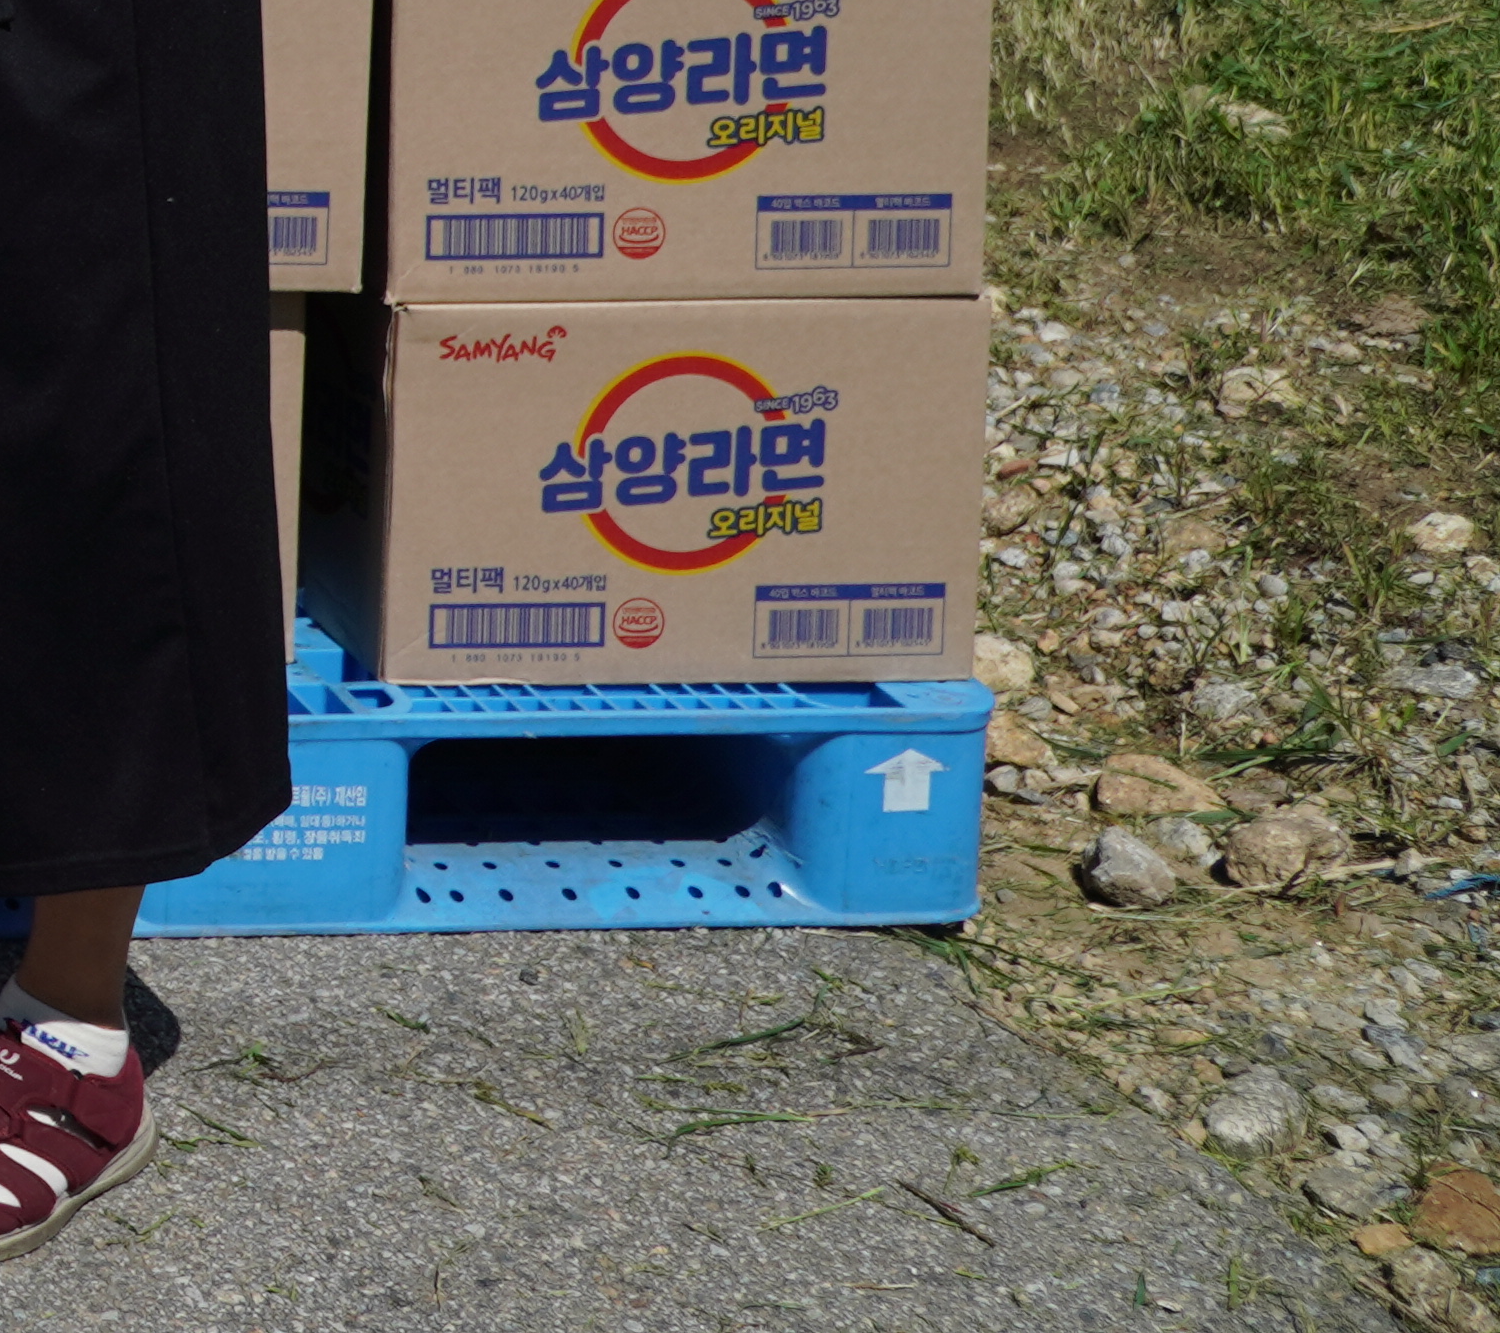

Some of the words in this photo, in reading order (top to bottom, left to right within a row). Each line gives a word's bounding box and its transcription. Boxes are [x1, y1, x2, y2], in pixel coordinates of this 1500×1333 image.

[754, 4, 789, 20] SINCE
[535, 25, 828, 122] 삼양라면
[706, 106, 825, 148] 오리지널
[427, 177, 502, 205] 멀티팩
[621, 226, 659, 237] HACCP
[439, 334, 557, 364] SAMYANG
[754, 397, 789, 412] SINCE
[789, 386, 839, 413] 1963
[540, 418, 826, 513] 삼양라면
[706, 497, 823, 539] 오리지널
[431, 567, 505, 594] 멀티팩
[621, 615, 658, 626] HACCP
[334, 785, 367, 807] 재산임
